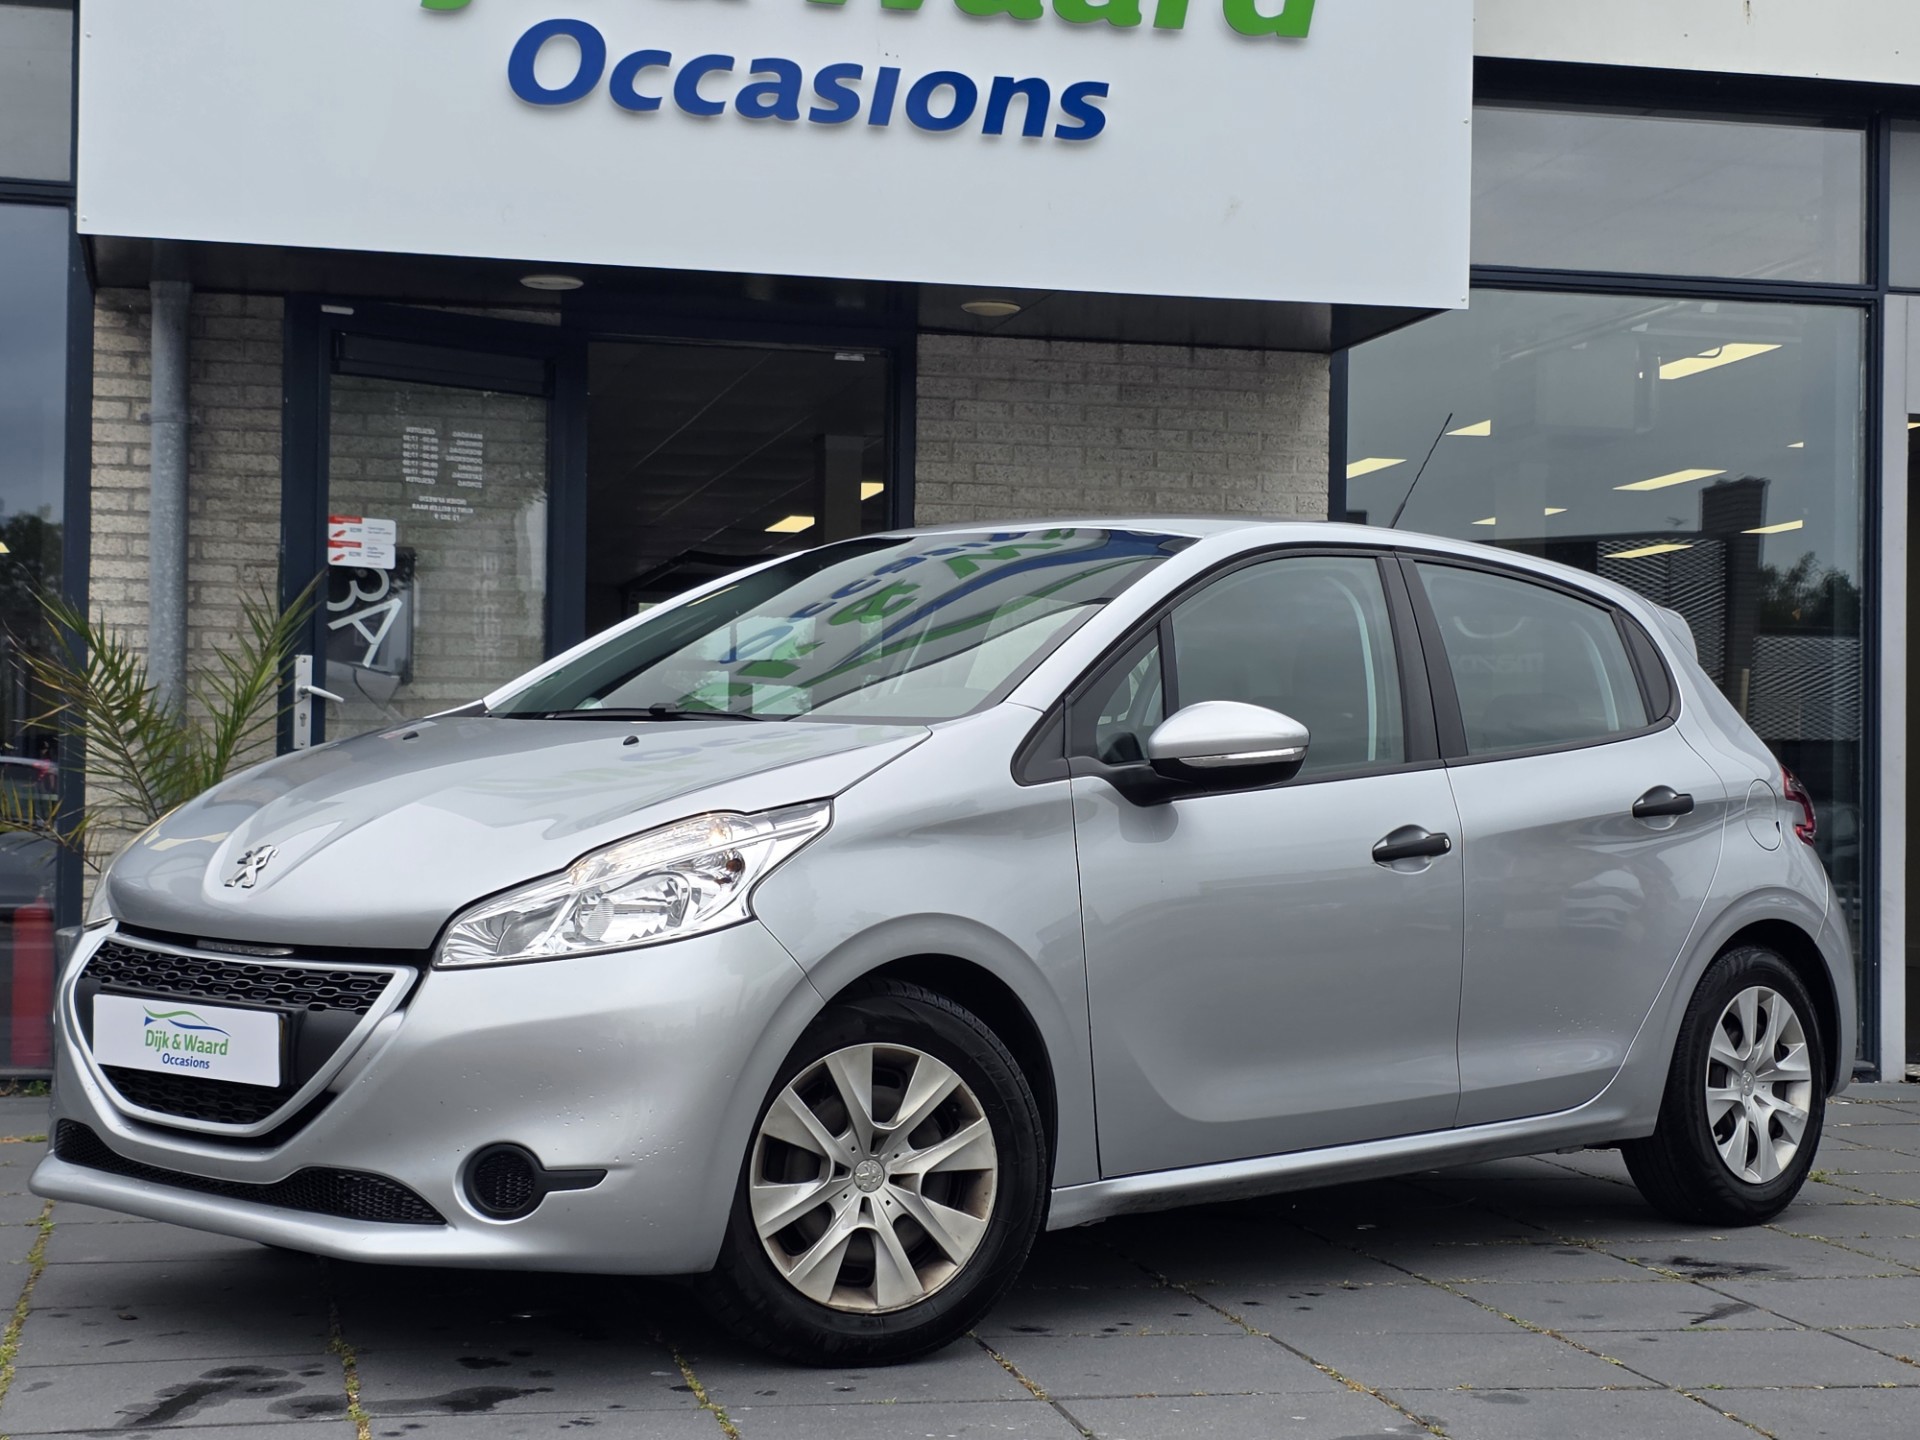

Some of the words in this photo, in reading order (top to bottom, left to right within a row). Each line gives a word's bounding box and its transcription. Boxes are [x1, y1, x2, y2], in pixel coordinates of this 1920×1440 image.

[507, 17, 1110, 142] Occasions
[145, 1029, 169, 1051] Dijk
[172, 1033, 181, 1049] &
[184, 1034, 229, 1055] Waard
[162, 1053, 210, 1069] Occasions
